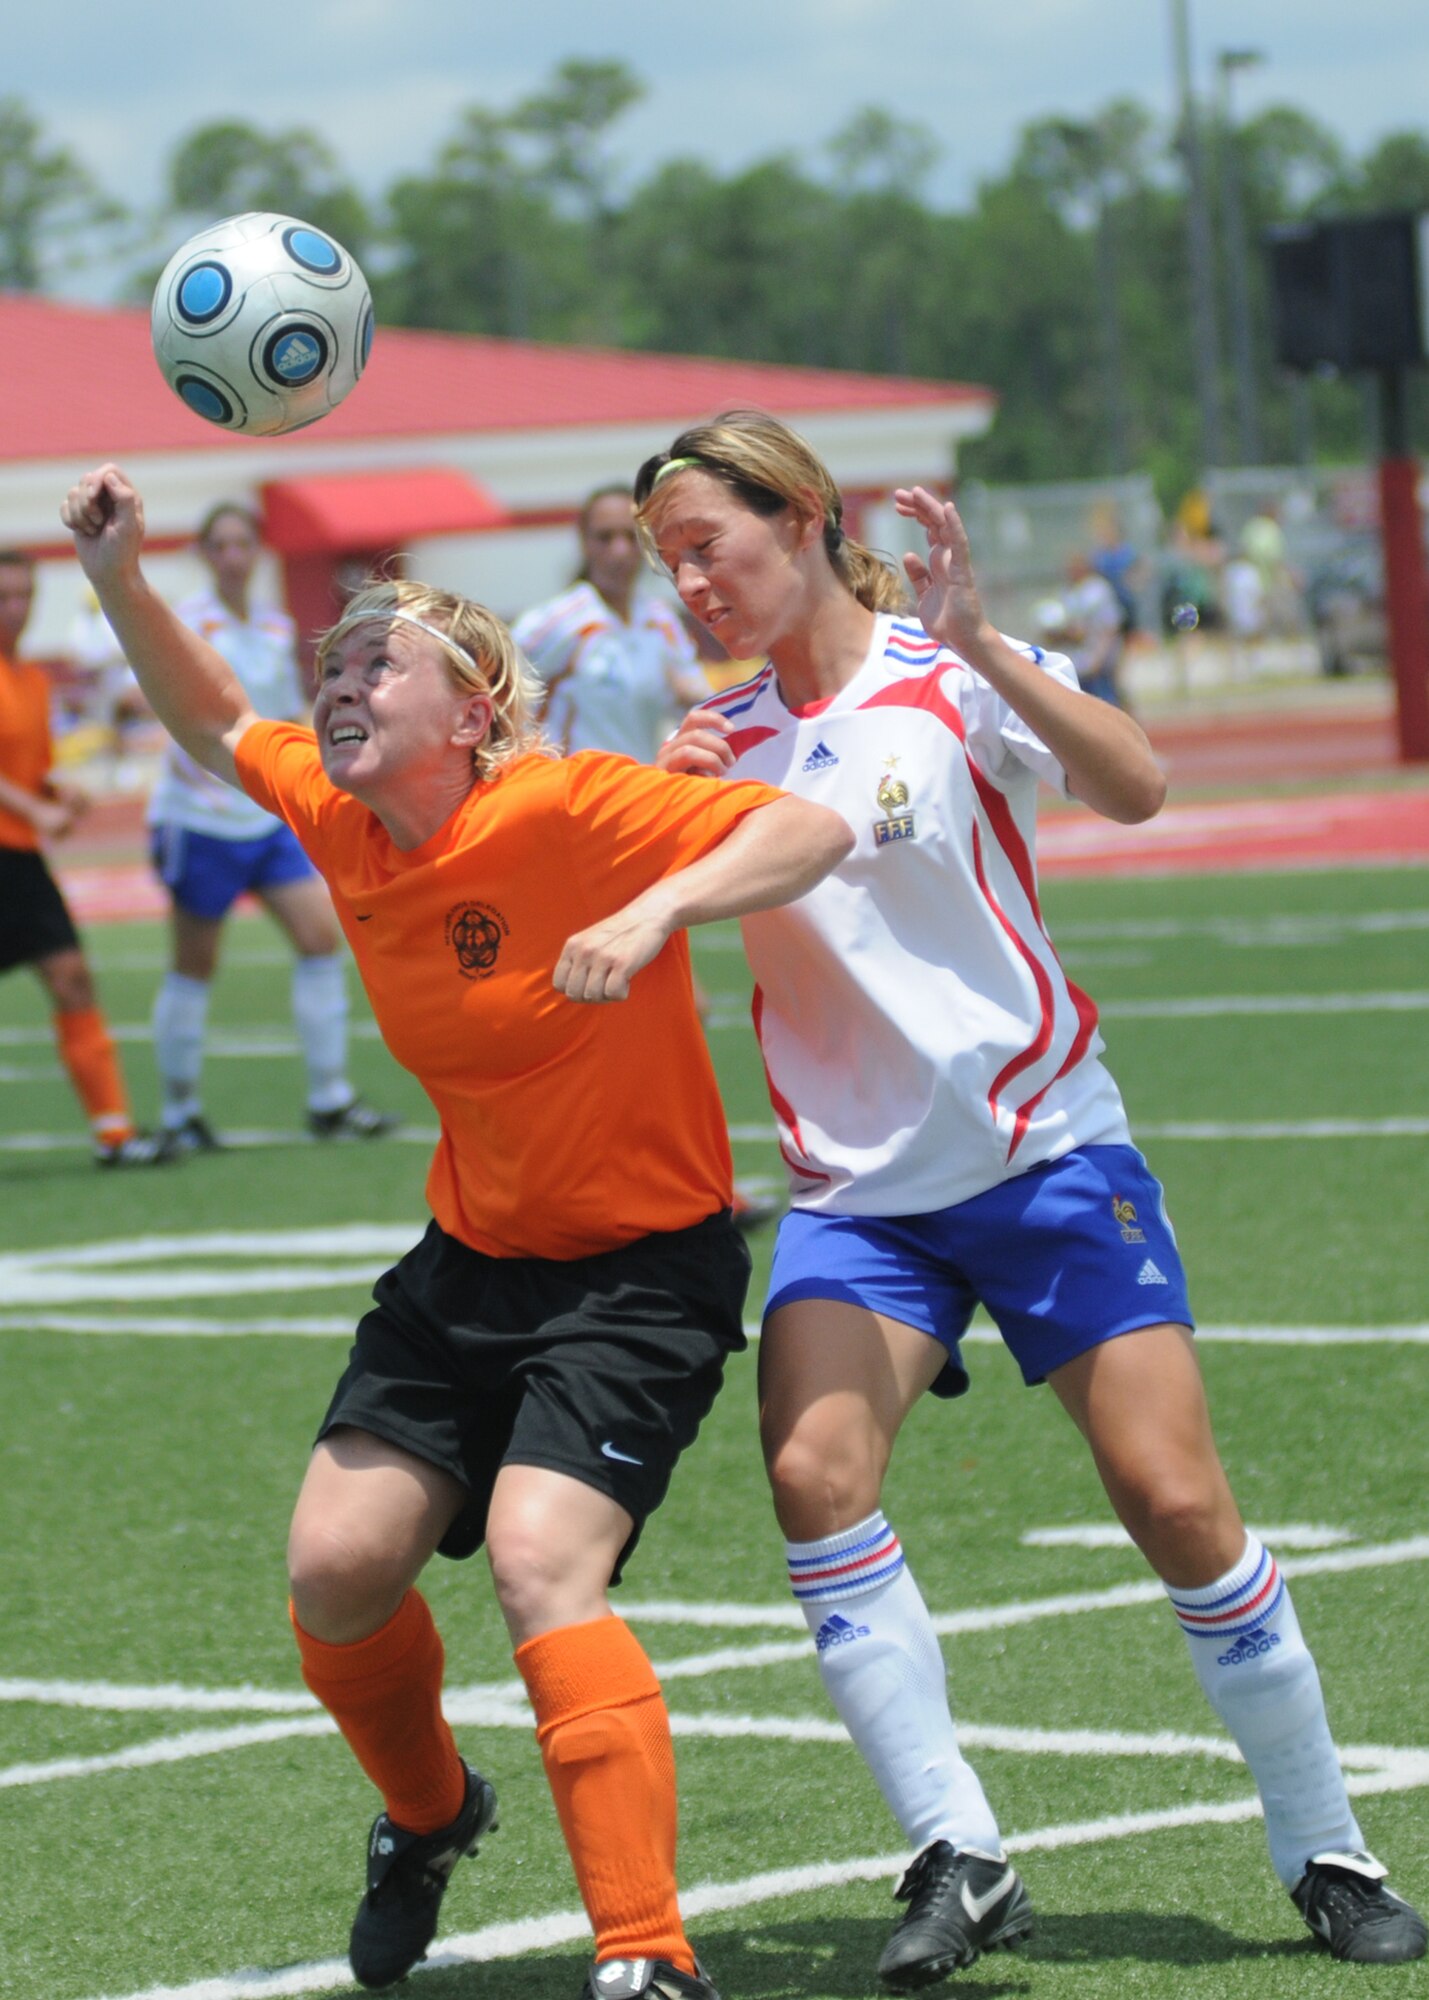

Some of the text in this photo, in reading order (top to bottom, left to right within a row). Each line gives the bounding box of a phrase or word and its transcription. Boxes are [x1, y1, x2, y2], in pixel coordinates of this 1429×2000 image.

[802, 756, 839, 772] adidas
[816, 1625, 872, 1651] didas
[1217, 1633, 1281, 1666] adidas
